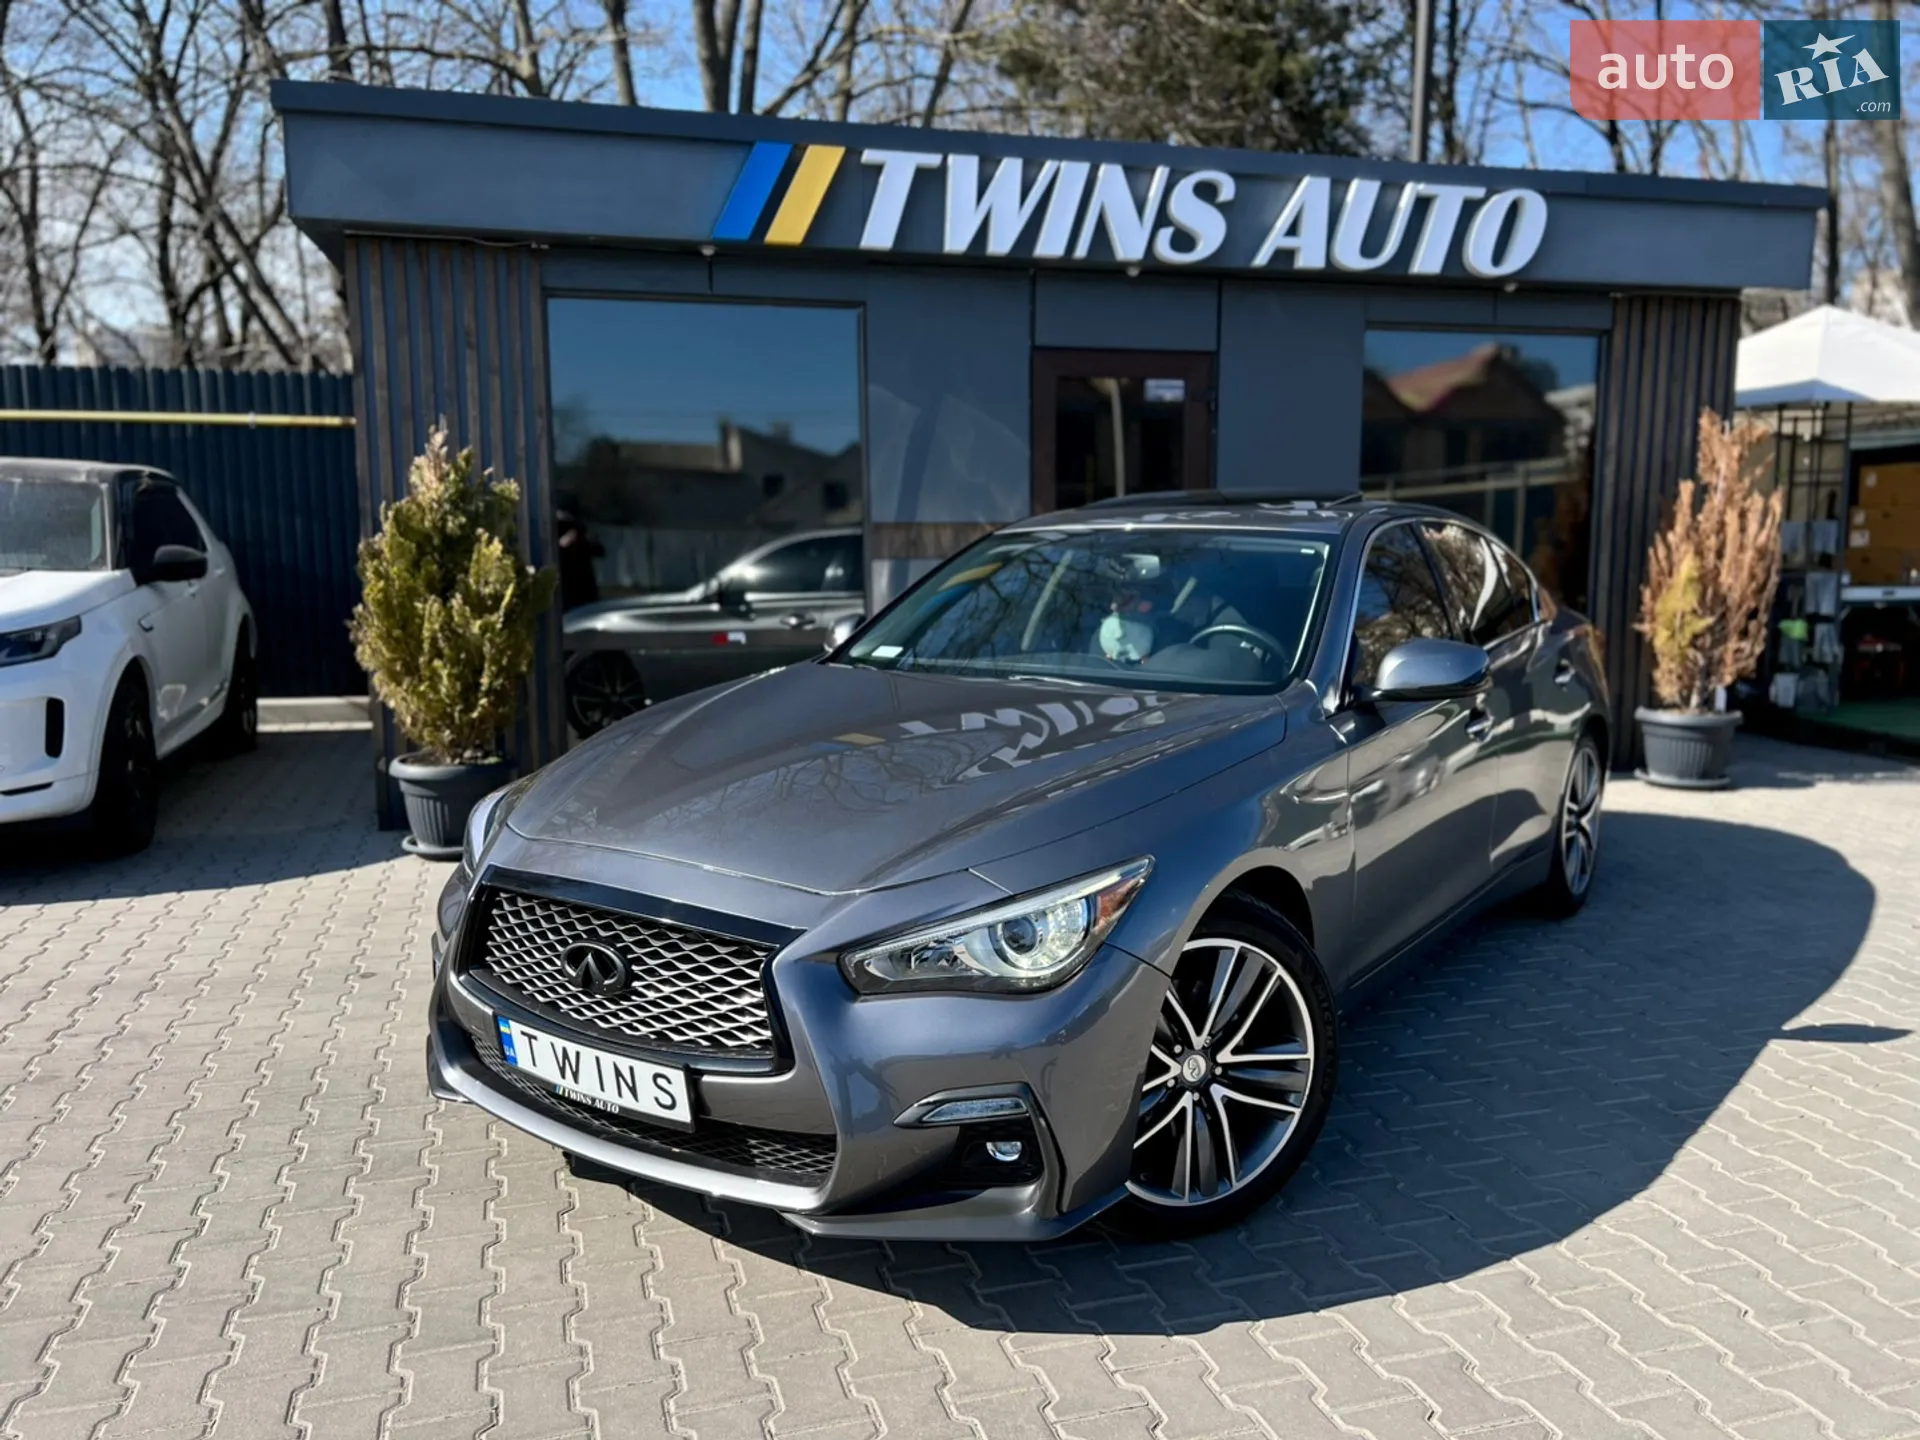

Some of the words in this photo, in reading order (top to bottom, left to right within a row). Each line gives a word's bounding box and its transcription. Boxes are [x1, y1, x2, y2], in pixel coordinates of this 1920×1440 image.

[859, 148, 1236, 265] TWINS
[1250, 174, 1548, 278] AUTO
[520, 1030, 677, 1111] TWINS
[1313, 984, 1334, 1091] MICHELIN
[564, 1088, 592, 1106] TWINS
[593, 1098, 620, 1114] AUTO
